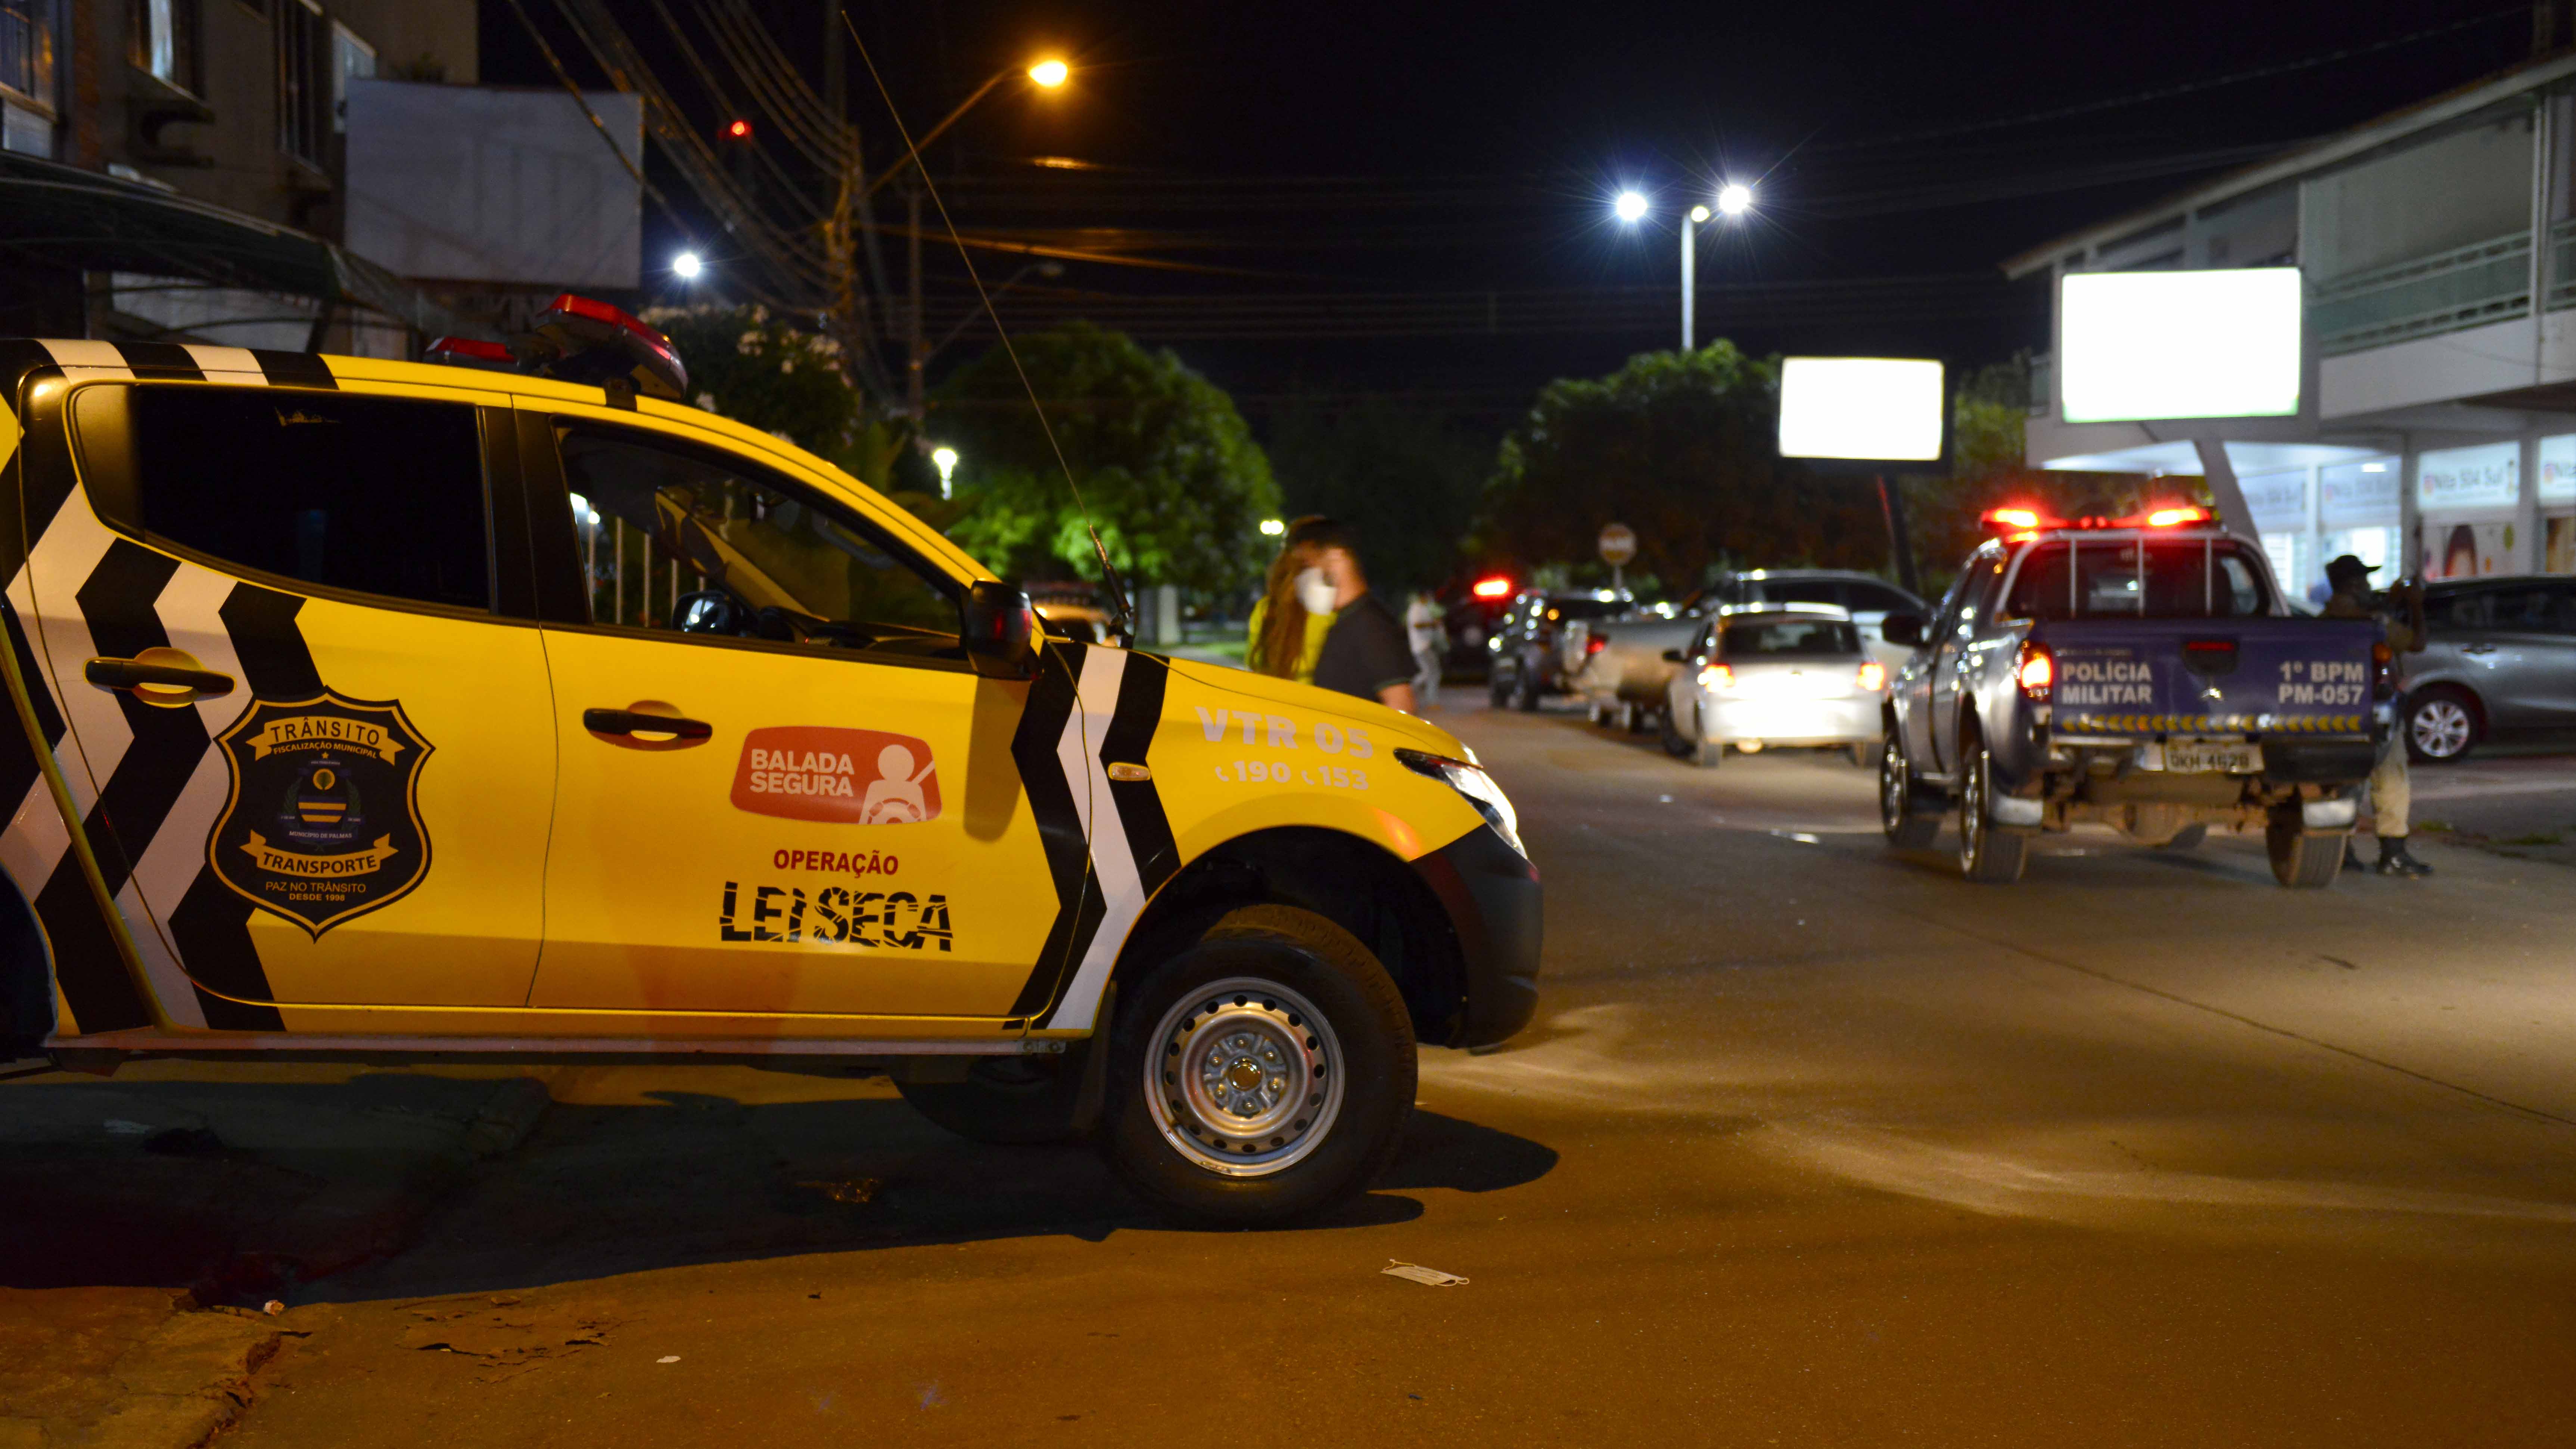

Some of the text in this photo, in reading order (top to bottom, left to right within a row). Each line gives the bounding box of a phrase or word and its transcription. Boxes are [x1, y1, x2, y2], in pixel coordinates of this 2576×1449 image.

[2062, 658, 2152, 682] POLÍCIA
[2310, 661, 2364, 682] BPM
[2062, 684, 2152, 704] MILITAR
[2278, 683, 2365, 705] PM-057
[271, 717, 379, 745] TRÂNSITO
[1195, 705, 1373, 759] VTR 05
[273, 741, 377, 758] FISCALIZAÇÃO MUNICIPAL
[751, 748, 855, 775] BALADA
[749, 771, 854, 797] SEGURA
[1233, 760, 1369, 791] 190 153
[263, 851, 377, 874] TRANSPORTE
[773, 849, 899, 879] OPERAÇÃO
[265, 881, 366, 893] PAZ NO TRÂNSITO
[719, 881, 953, 952] LEI SECA
